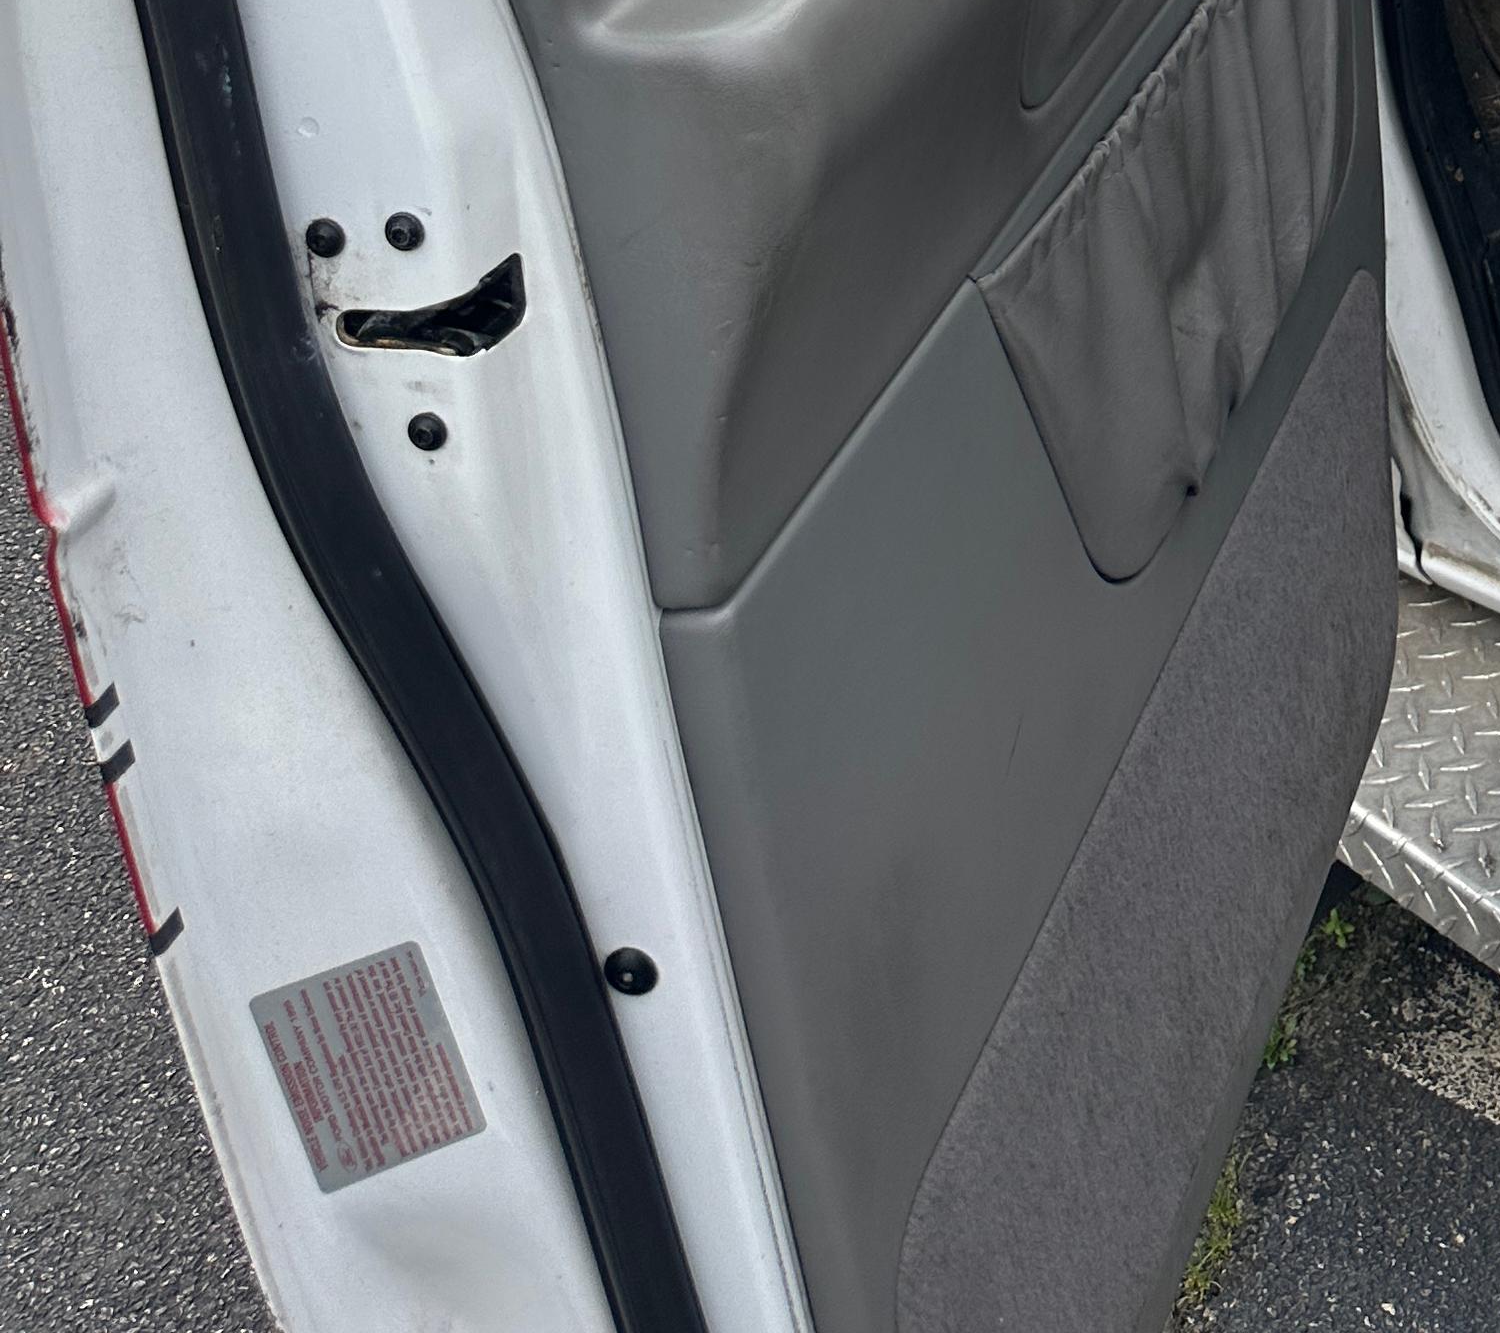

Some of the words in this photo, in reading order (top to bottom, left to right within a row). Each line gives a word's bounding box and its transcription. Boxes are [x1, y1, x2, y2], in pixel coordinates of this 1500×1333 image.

[261, 1019, 288, 1063] CONTROL
[290, 1022, 319, 1076] COMPANY
[310, 1073, 334, 1115] MOTOR
